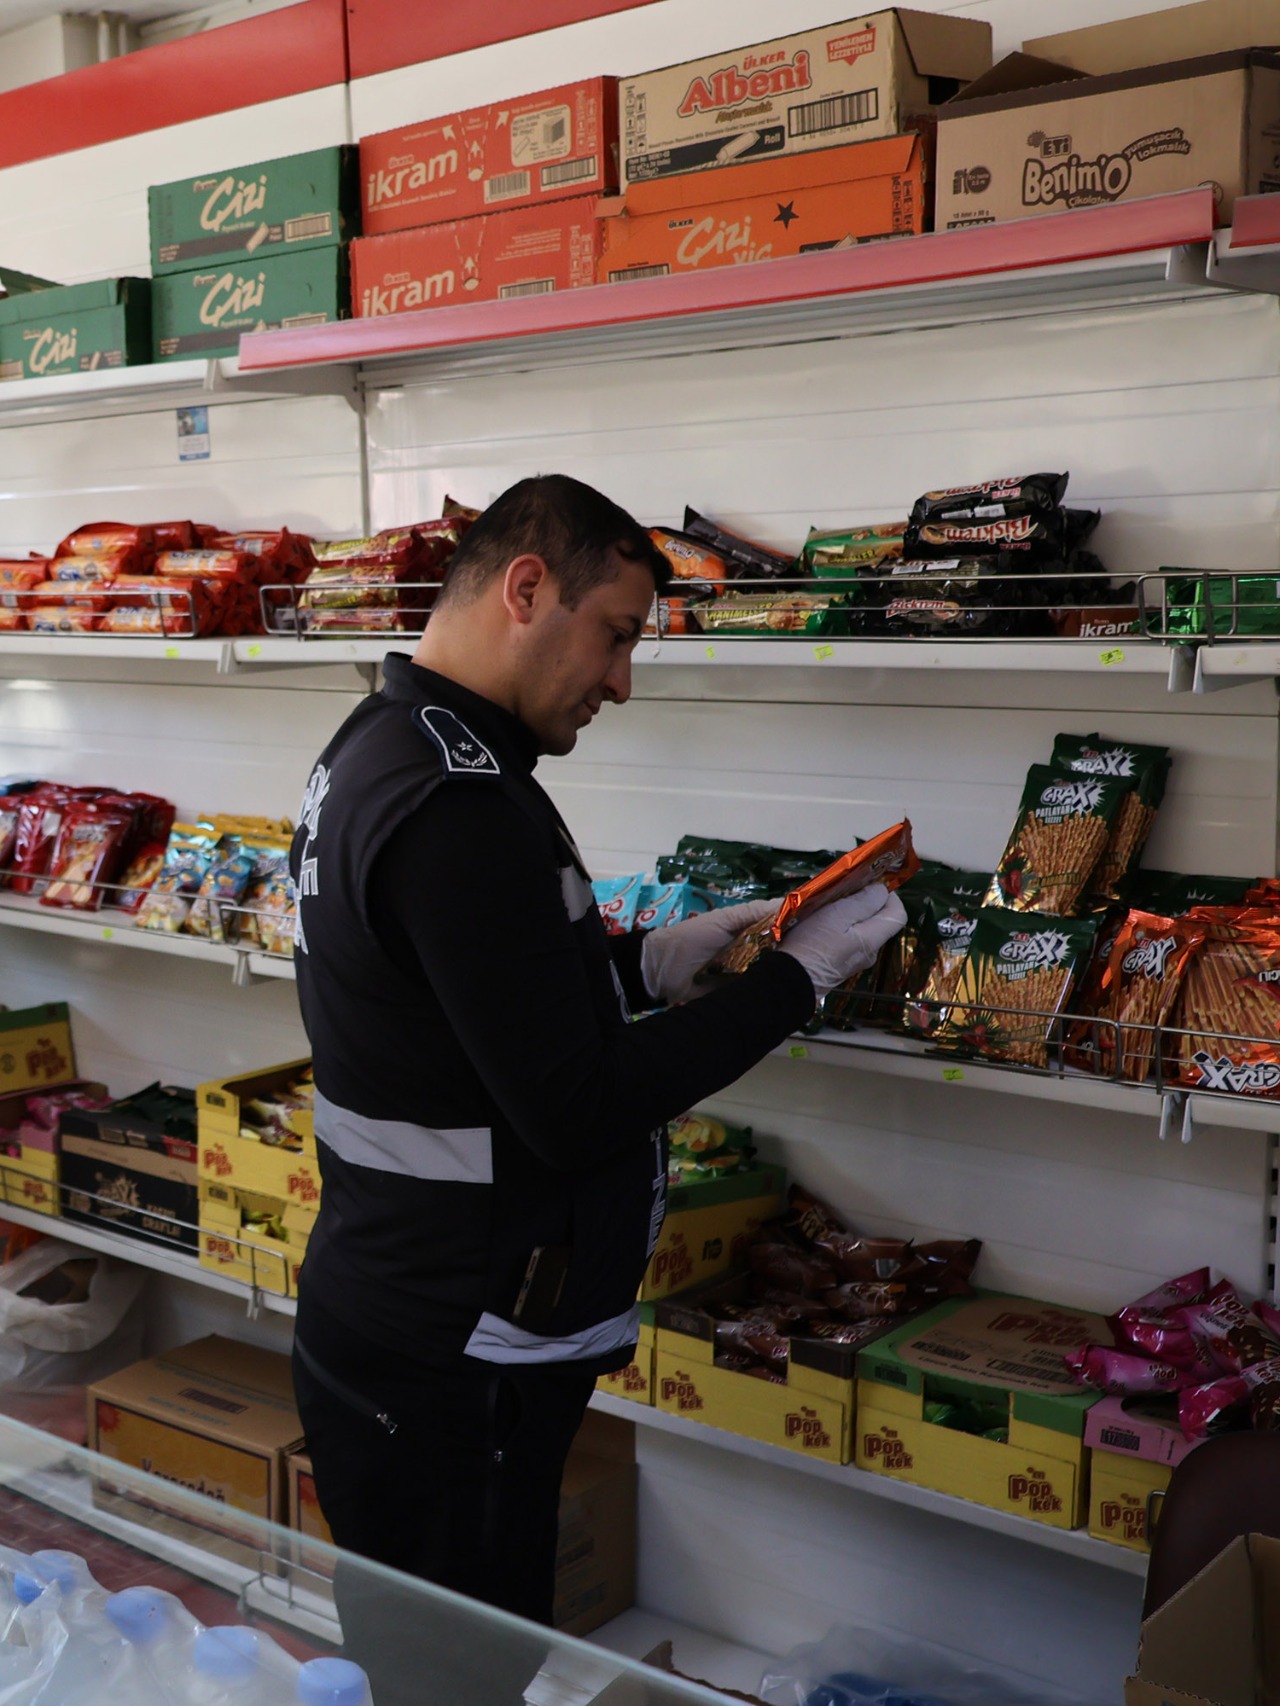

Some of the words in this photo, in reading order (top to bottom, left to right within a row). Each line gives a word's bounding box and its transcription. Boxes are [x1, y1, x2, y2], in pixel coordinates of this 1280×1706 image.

[744, 51, 786, 71] ÜLKER
[680, 52, 810, 116] Albeni
[764, 133, 780, 145] Roll
[368, 150, 458, 206] ikram
[200, 175, 267, 232] Çizi
[676, 216, 753, 266] Çizi
[200, 272, 266, 327] Çizi
[362, 270, 455, 317] ikram
[945, 515, 1038, 545] Biskrem
[1041, 783, 1100, 813] CRAX
[999, 934, 1064, 965] CRAX
[1122, 937, 1176, 981] CRAX
[1259, 969, 1280, 982] CILI
[1194, 1051, 1280, 1092] CRAX
[662, 1378, 696, 1401] Pop
[680, 1395, 704, 1411] kek
[786, 1413, 822, 1437] Pop
[803, 1433, 831, 1449] kek
[865, 1434, 904, 1460] Pop
[884, 1454, 914, 1470] kek
[1008, 1475, 1052, 1501] Pop
[1029, 1495, 1063, 1512] kek
[1101, 1501, 1147, 1529] Pop
[1124, 1525, 1146, 1539] ke
